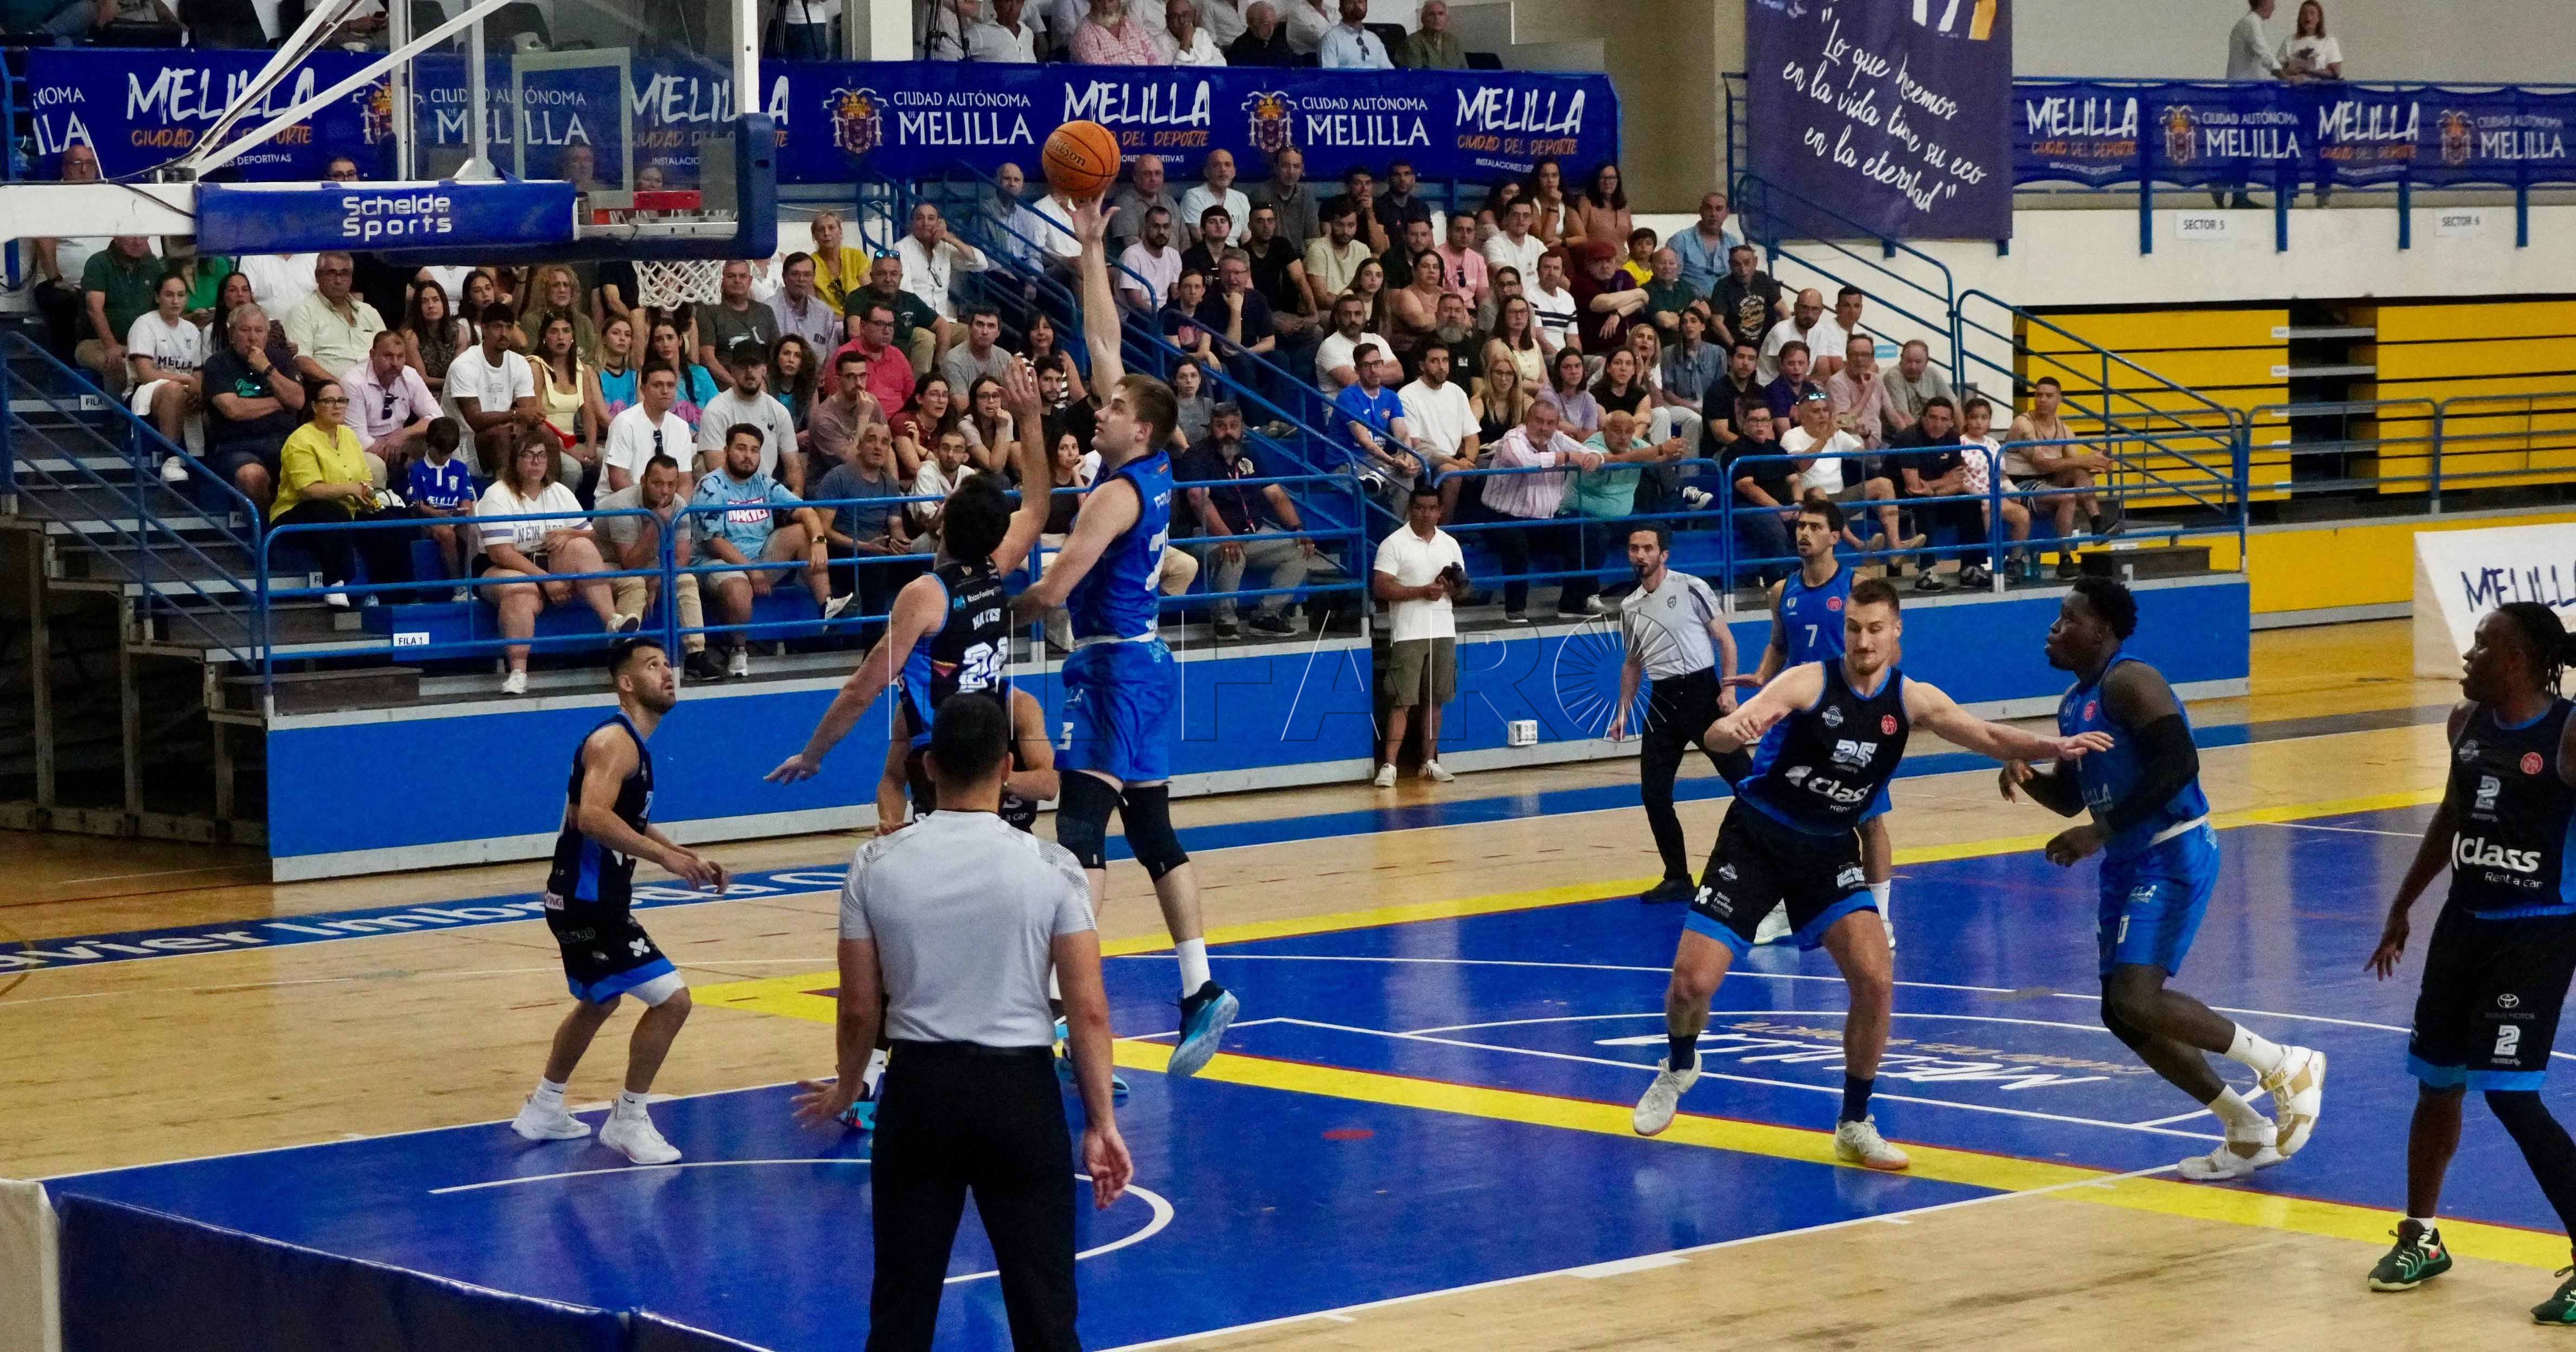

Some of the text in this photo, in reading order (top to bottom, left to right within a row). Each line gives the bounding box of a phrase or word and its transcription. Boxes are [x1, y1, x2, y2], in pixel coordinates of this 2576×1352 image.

[1848, 48, 1890, 89] que
[431, 86, 586, 105] CIUDD AUÓNOMA
[630, 73, 789, 126] MELILA
[894, 89, 1031, 107] CIUDAD AUTÓNOMA
[1063, 80, 1210, 126] MELILLA
[1302, 95, 1428, 111] CIUDAD AUTÓNOMA
[1456, 86, 1585, 134] MELILLA
[1782, 61, 1806, 91] en
[1810, 60, 1833, 104] la
[1837, 88, 1881, 126] vida
[1923, 143, 1947, 168] su
[1950, 158, 1987, 184] eco
[2026, 96, 2138, 138] MELILLA
[2317, 100, 2420, 143] MELILLA
[131, 127, 194, 148] CIUDAD
[435, 109, 591, 145] MLLLA
[897, 111, 1035, 145] MELILLA
[1122, 130, 1147, 146] DEL
[1154, 130, 1209, 147] DEPORTE
[1305, 114, 1431, 146] MELILLA
[1804, 127, 1828, 157] en
[1833, 124, 1858, 168] la
[2205, 128, 2302, 158] MELILLA
[2480, 131, 2566, 159] MELILLA
[237, 153, 292, 165] DEPORTIVAS
[652, 157, 700, 165] INSTALACIO
[343, 194, 451, 216] Schelde
[343, 215, 452, 242] Sports
[2184, 219, 2217, 230] SECTOR
[2442, 216, 2471, 227] SECTOR
[518, 525, 540, 544] NEW
[2460, 563, 2576, 613] MELILL
[398, 636, 423, 645] FILA 1
[1805, 624, 1818, 647] 7
[1831, 739, 1878, 768] 25
[2474, 775, 2501, 810] 2
[1013, 813, 1028, 821] car
[2484, 871, 2542, 889] Rent a car
[261, 883, 787, 936] Imbrda
[1713, 897, 1734, 912] Feeling
[1716, 891, 1731, 903] Ibiza
[2494, 1025, 2520, 1055] 2
